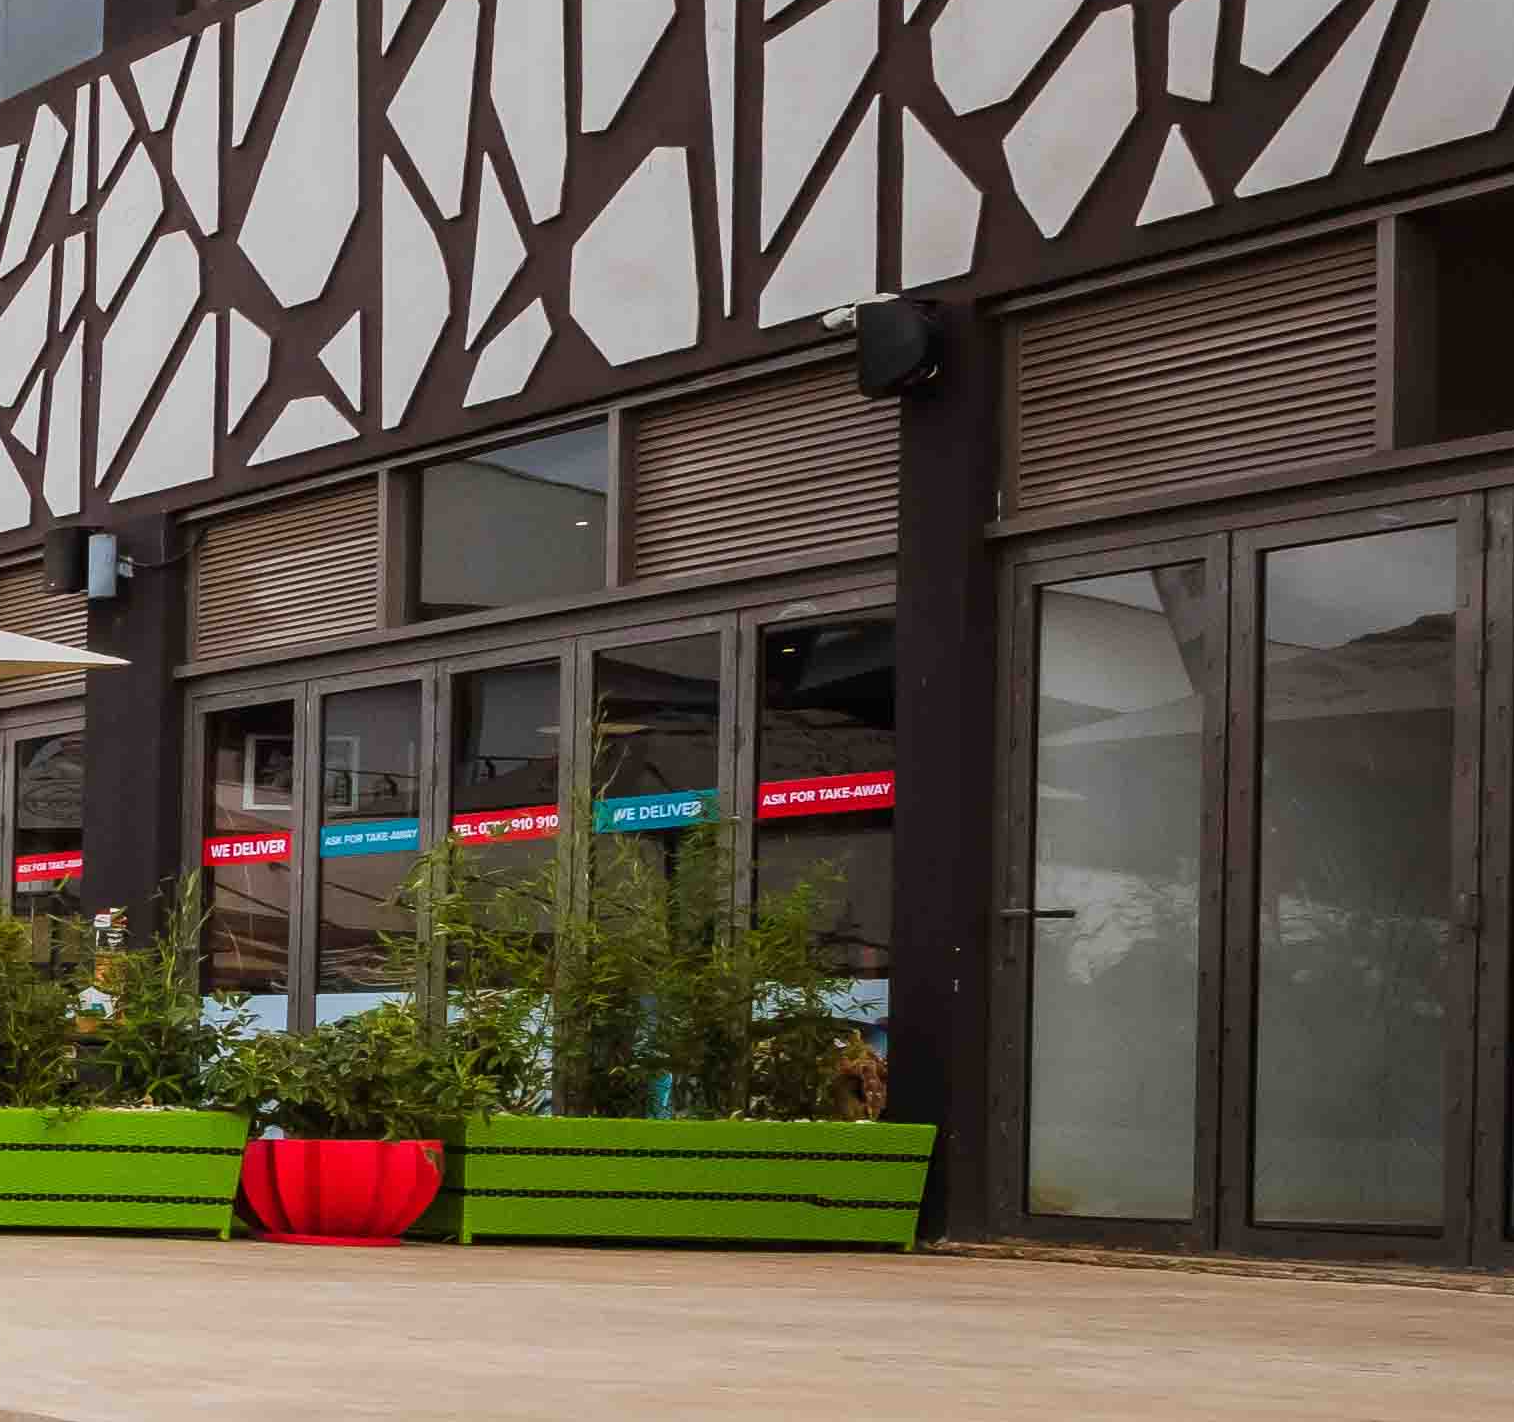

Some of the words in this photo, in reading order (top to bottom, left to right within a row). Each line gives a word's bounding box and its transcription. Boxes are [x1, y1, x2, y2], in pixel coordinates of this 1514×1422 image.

[762, 794, 787, 807] ASK
[790, 790, 816, 804] FOR
[819, 782, 892, 802] TAKE-AWAY
[452, 823, 478, 837] TEL:
[511, 817, 534, 831] 910
[536, 814, 559, 829] 910
[613, 808, 636, 824] WE
[324, 835, 342, 847] ASK
[343, 833, 364, 845] FOR
[364, 828, 419, 843] TAKE-AWAY
[210, 843, 231, 859] WE
[232, 839, 287, 857] DELIVER
